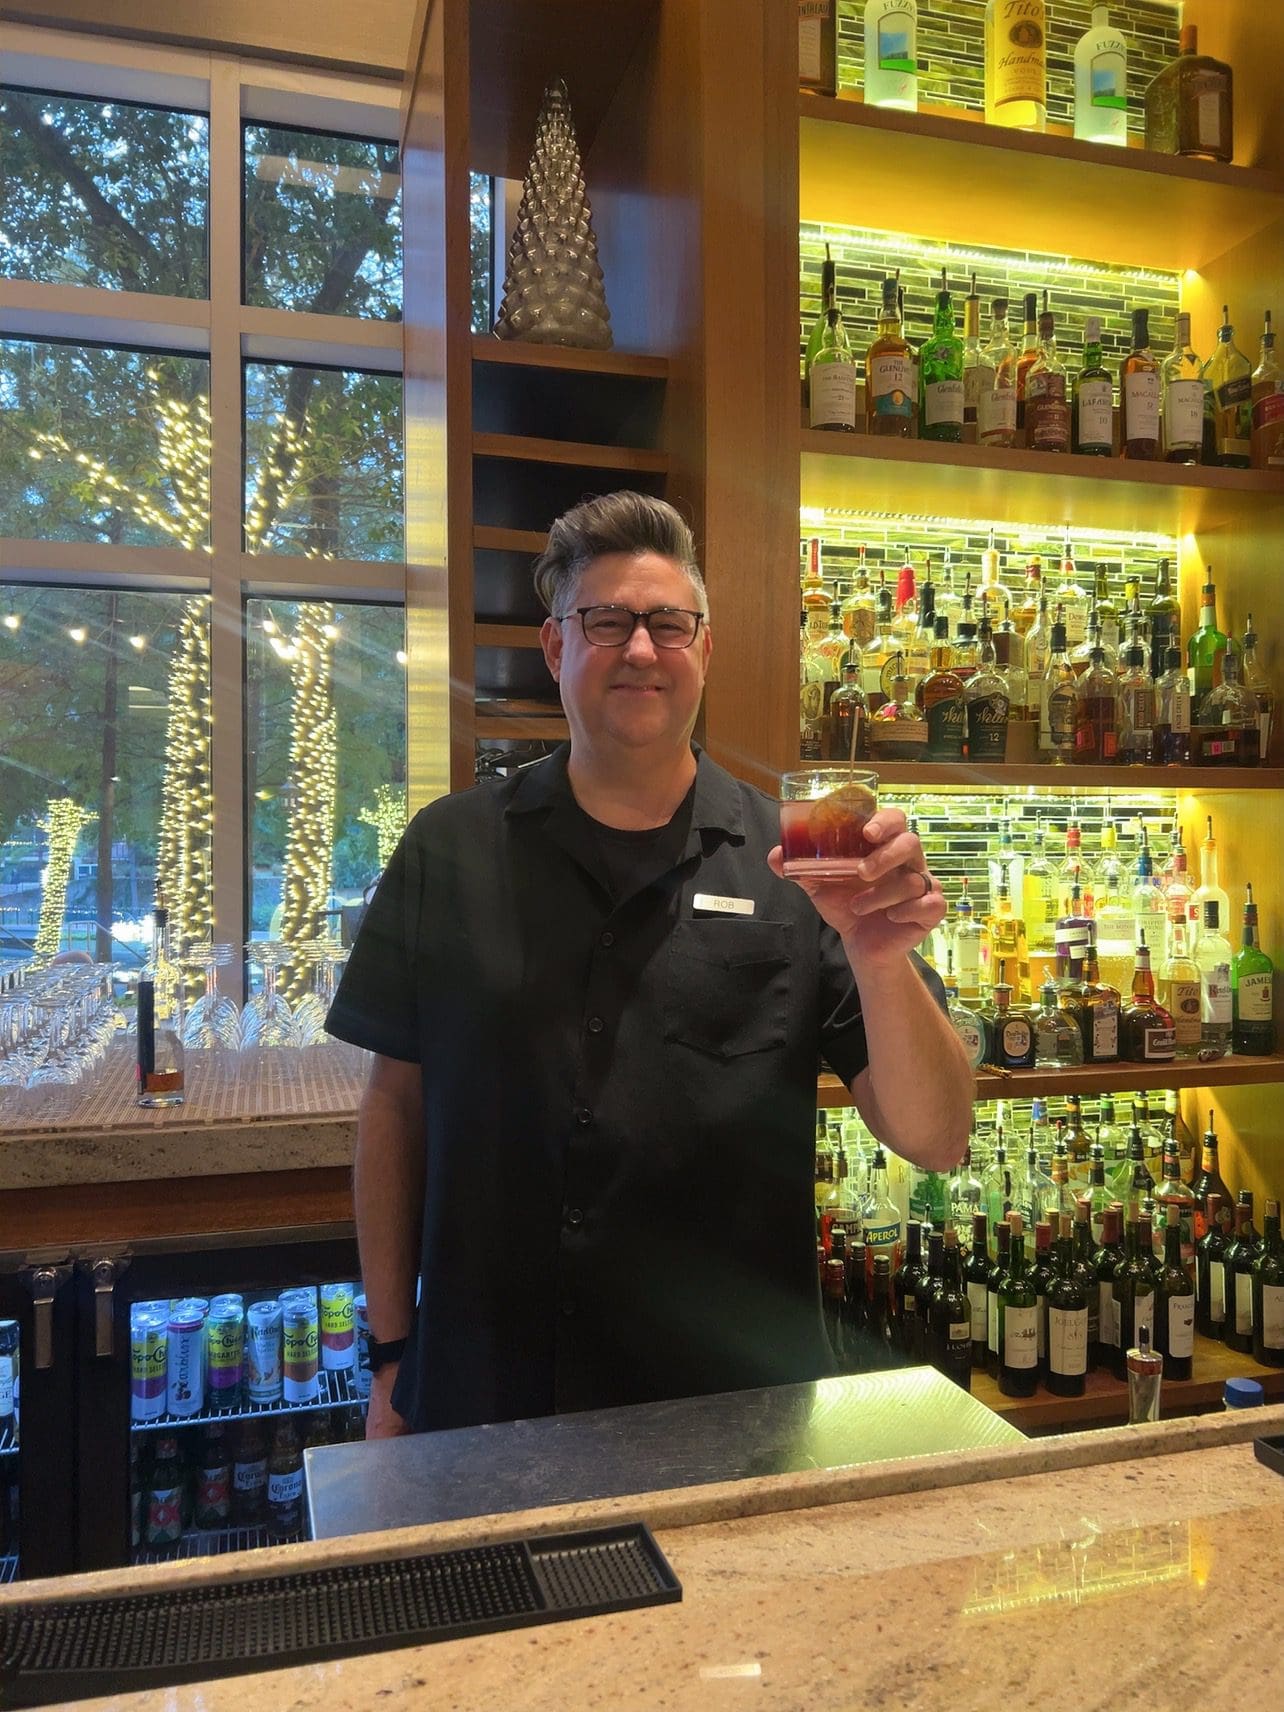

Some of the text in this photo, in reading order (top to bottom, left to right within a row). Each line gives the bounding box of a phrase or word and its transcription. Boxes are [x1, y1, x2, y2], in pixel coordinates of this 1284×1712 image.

[989, 732, 1001, 742] 12
[713, 900, 735, 910] ROB
[951, 1201, 979, 1213] PAMA
[866, 1228, 898, 1244] APEROL
